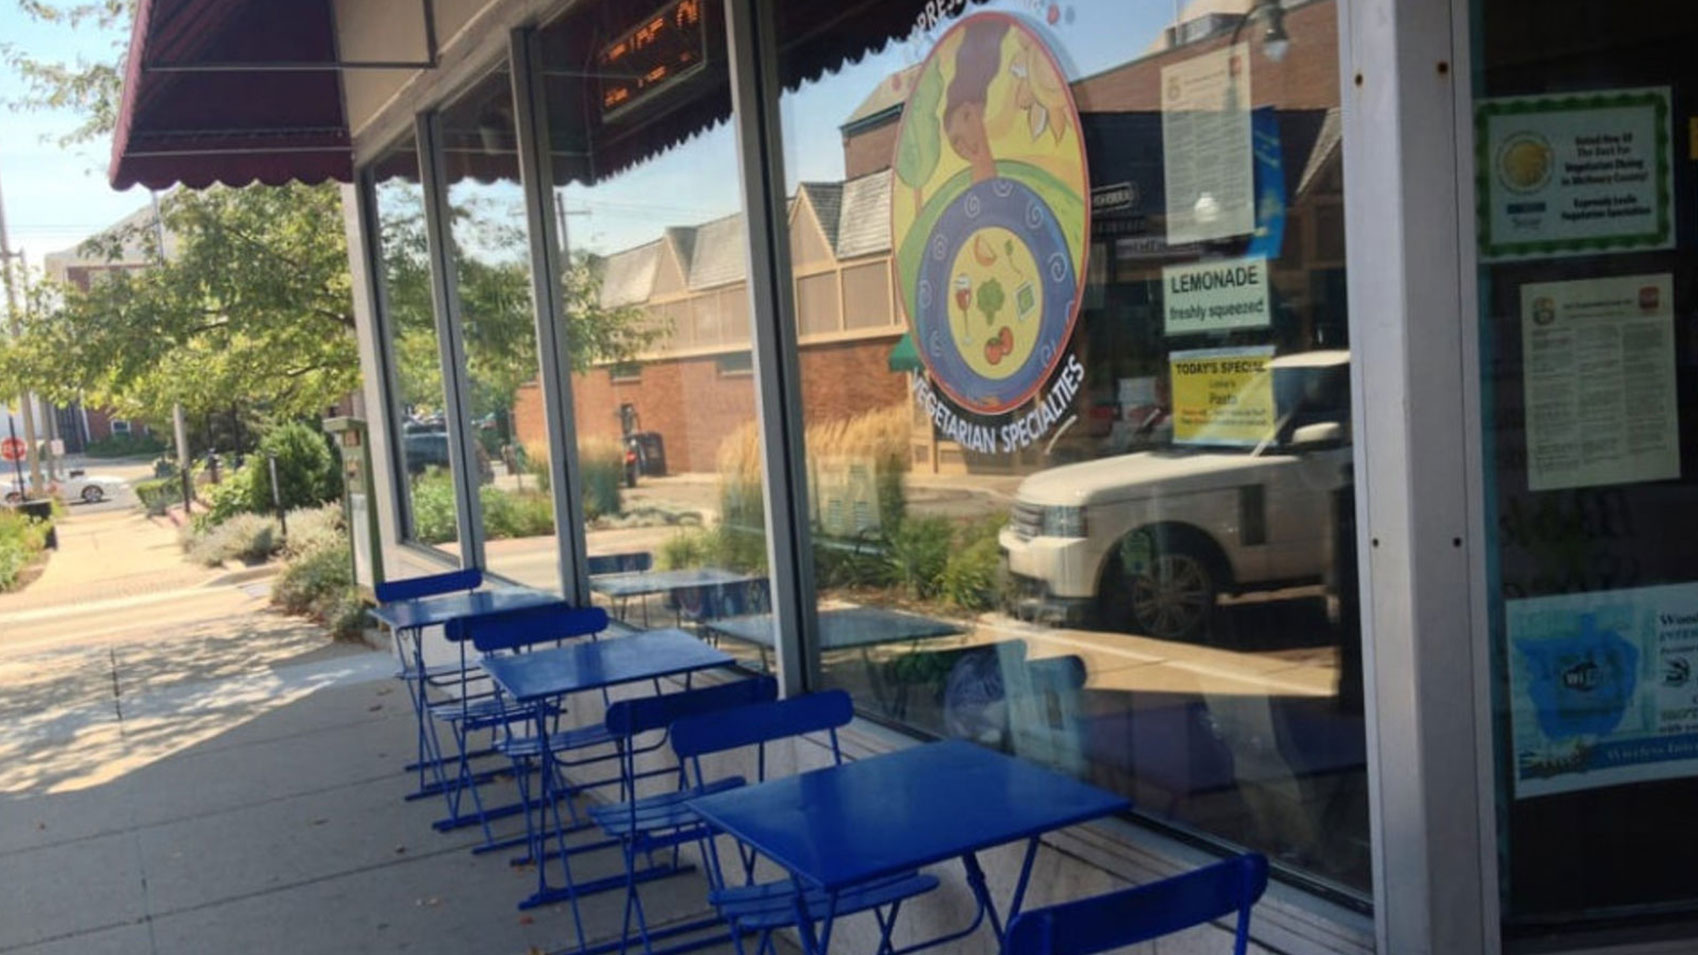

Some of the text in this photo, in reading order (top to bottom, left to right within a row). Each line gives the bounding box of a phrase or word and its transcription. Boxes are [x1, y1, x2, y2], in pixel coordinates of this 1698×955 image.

[1171, 265, 1260, 294] LEMONADE
[1169, 300, 1264, 322] freshly squeezed
[1176, 362, 1218, 375] TODAY'S
[912, 354, 1085, 454] VEGETARIAN SPECIALTIES
